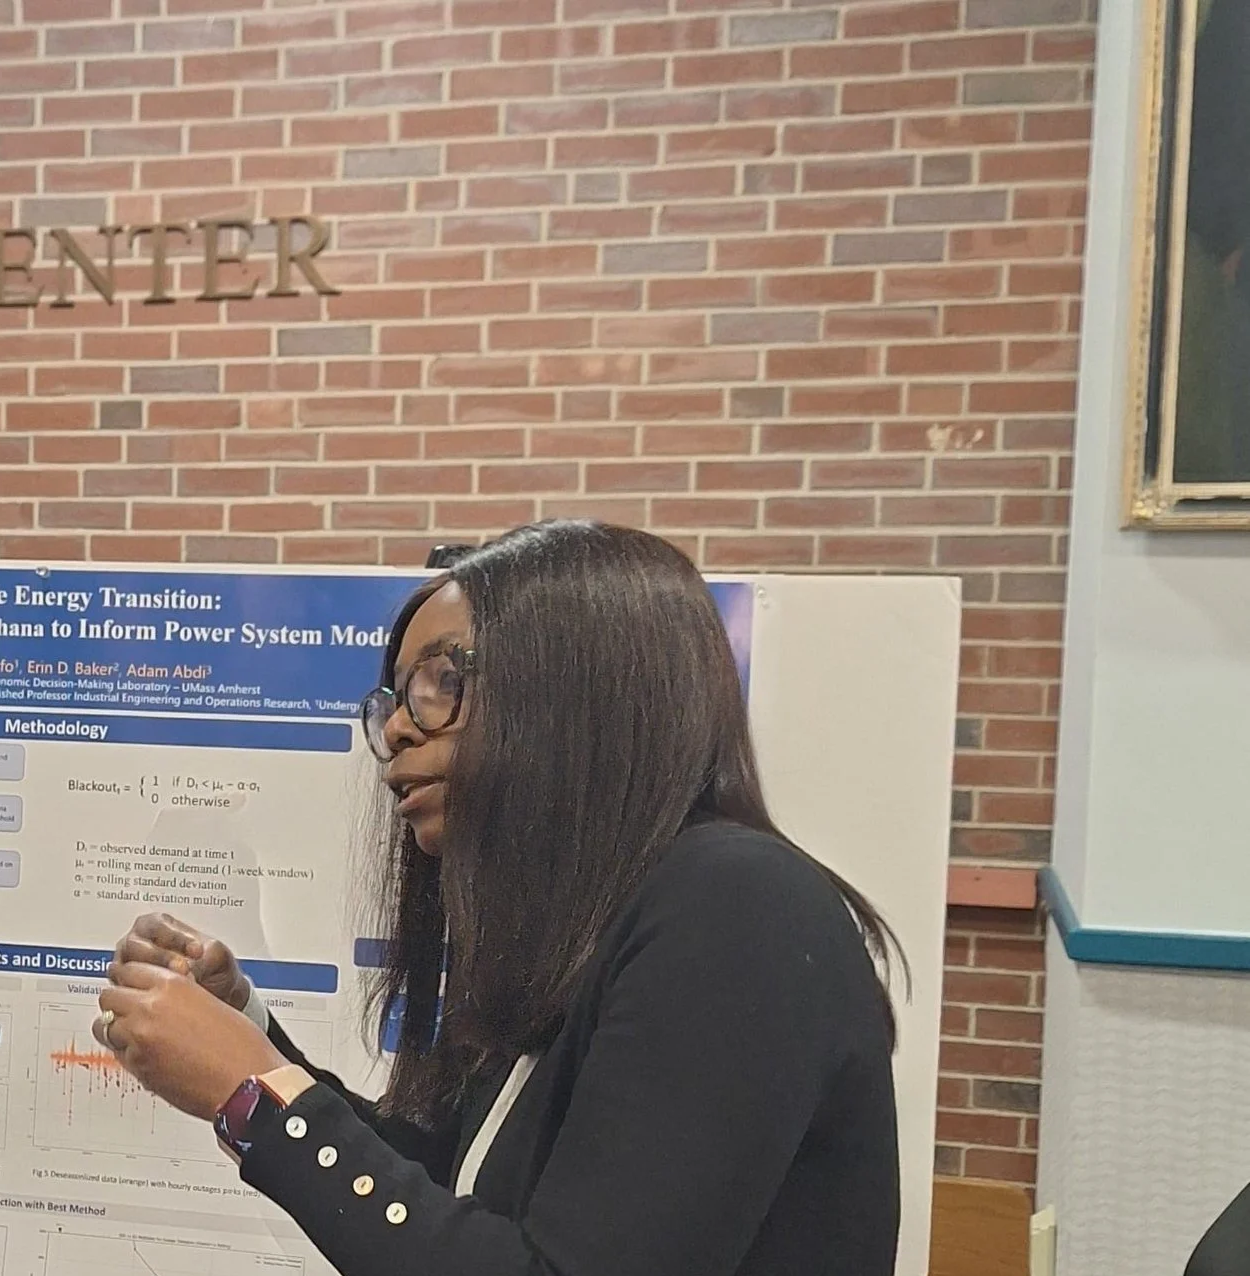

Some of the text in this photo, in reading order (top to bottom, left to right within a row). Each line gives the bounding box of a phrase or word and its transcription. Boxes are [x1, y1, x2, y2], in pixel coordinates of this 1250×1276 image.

[16, 585, 91, 611] Energy
[99, 587, 220, 609] Transition:
[51, 620, 71, 637] to
[79, 619, 156, 639] Inform
[164, 621, 235, 641] Power
[240, 623, 322, 647] System
[27, 660, 53, 673] Erin
[126, 664, 168, 677] Adam
[33, 678, 113, 692] Decision-Making
[117, 680, 171, 693] Laboratory
[182, 683, 215, 692] UMass
[217, 684, 260, 694] Amherst
[74, 690, 119, 701] Industrial
[122, 693, 180, 706] Engineering
[183, 696, 202, 705] and
[205, 696, 260, 707] Operations
[264, 698, 310, 709] Research,
[5, 719, 108, 738] Methodology
[172, 776, 179, 786] if
[171, 794, 230, 807] otherwise
[100, 843, 227, 858] observed demand at time
[97, 890, 244, 907] standard deviation multiplier
[12, 953, 40, 966] and
[25, 1200, 44, 1209] with
[47, 1202, 66, 1211] Best
[69, 1204, 105, 1215] Method
